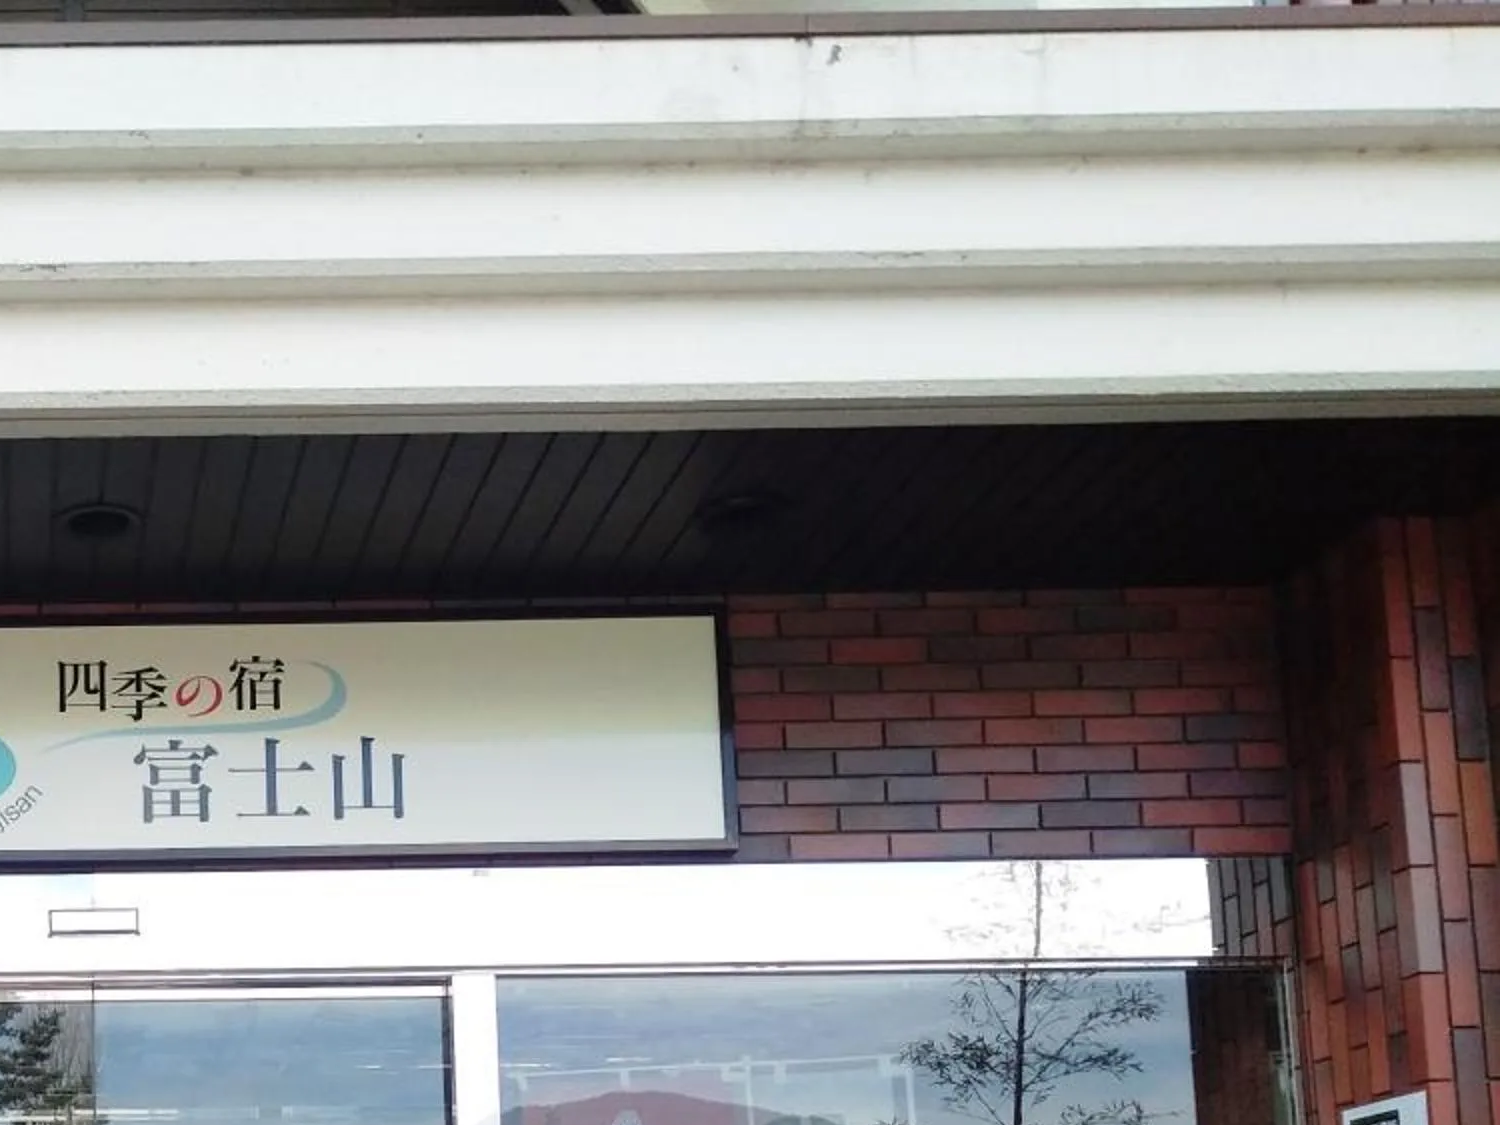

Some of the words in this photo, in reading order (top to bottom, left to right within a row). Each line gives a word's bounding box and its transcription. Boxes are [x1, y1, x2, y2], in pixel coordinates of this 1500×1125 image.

[56, 655, 286, 721] 四季の宿
[133, 736, 405, 823] 富士山
